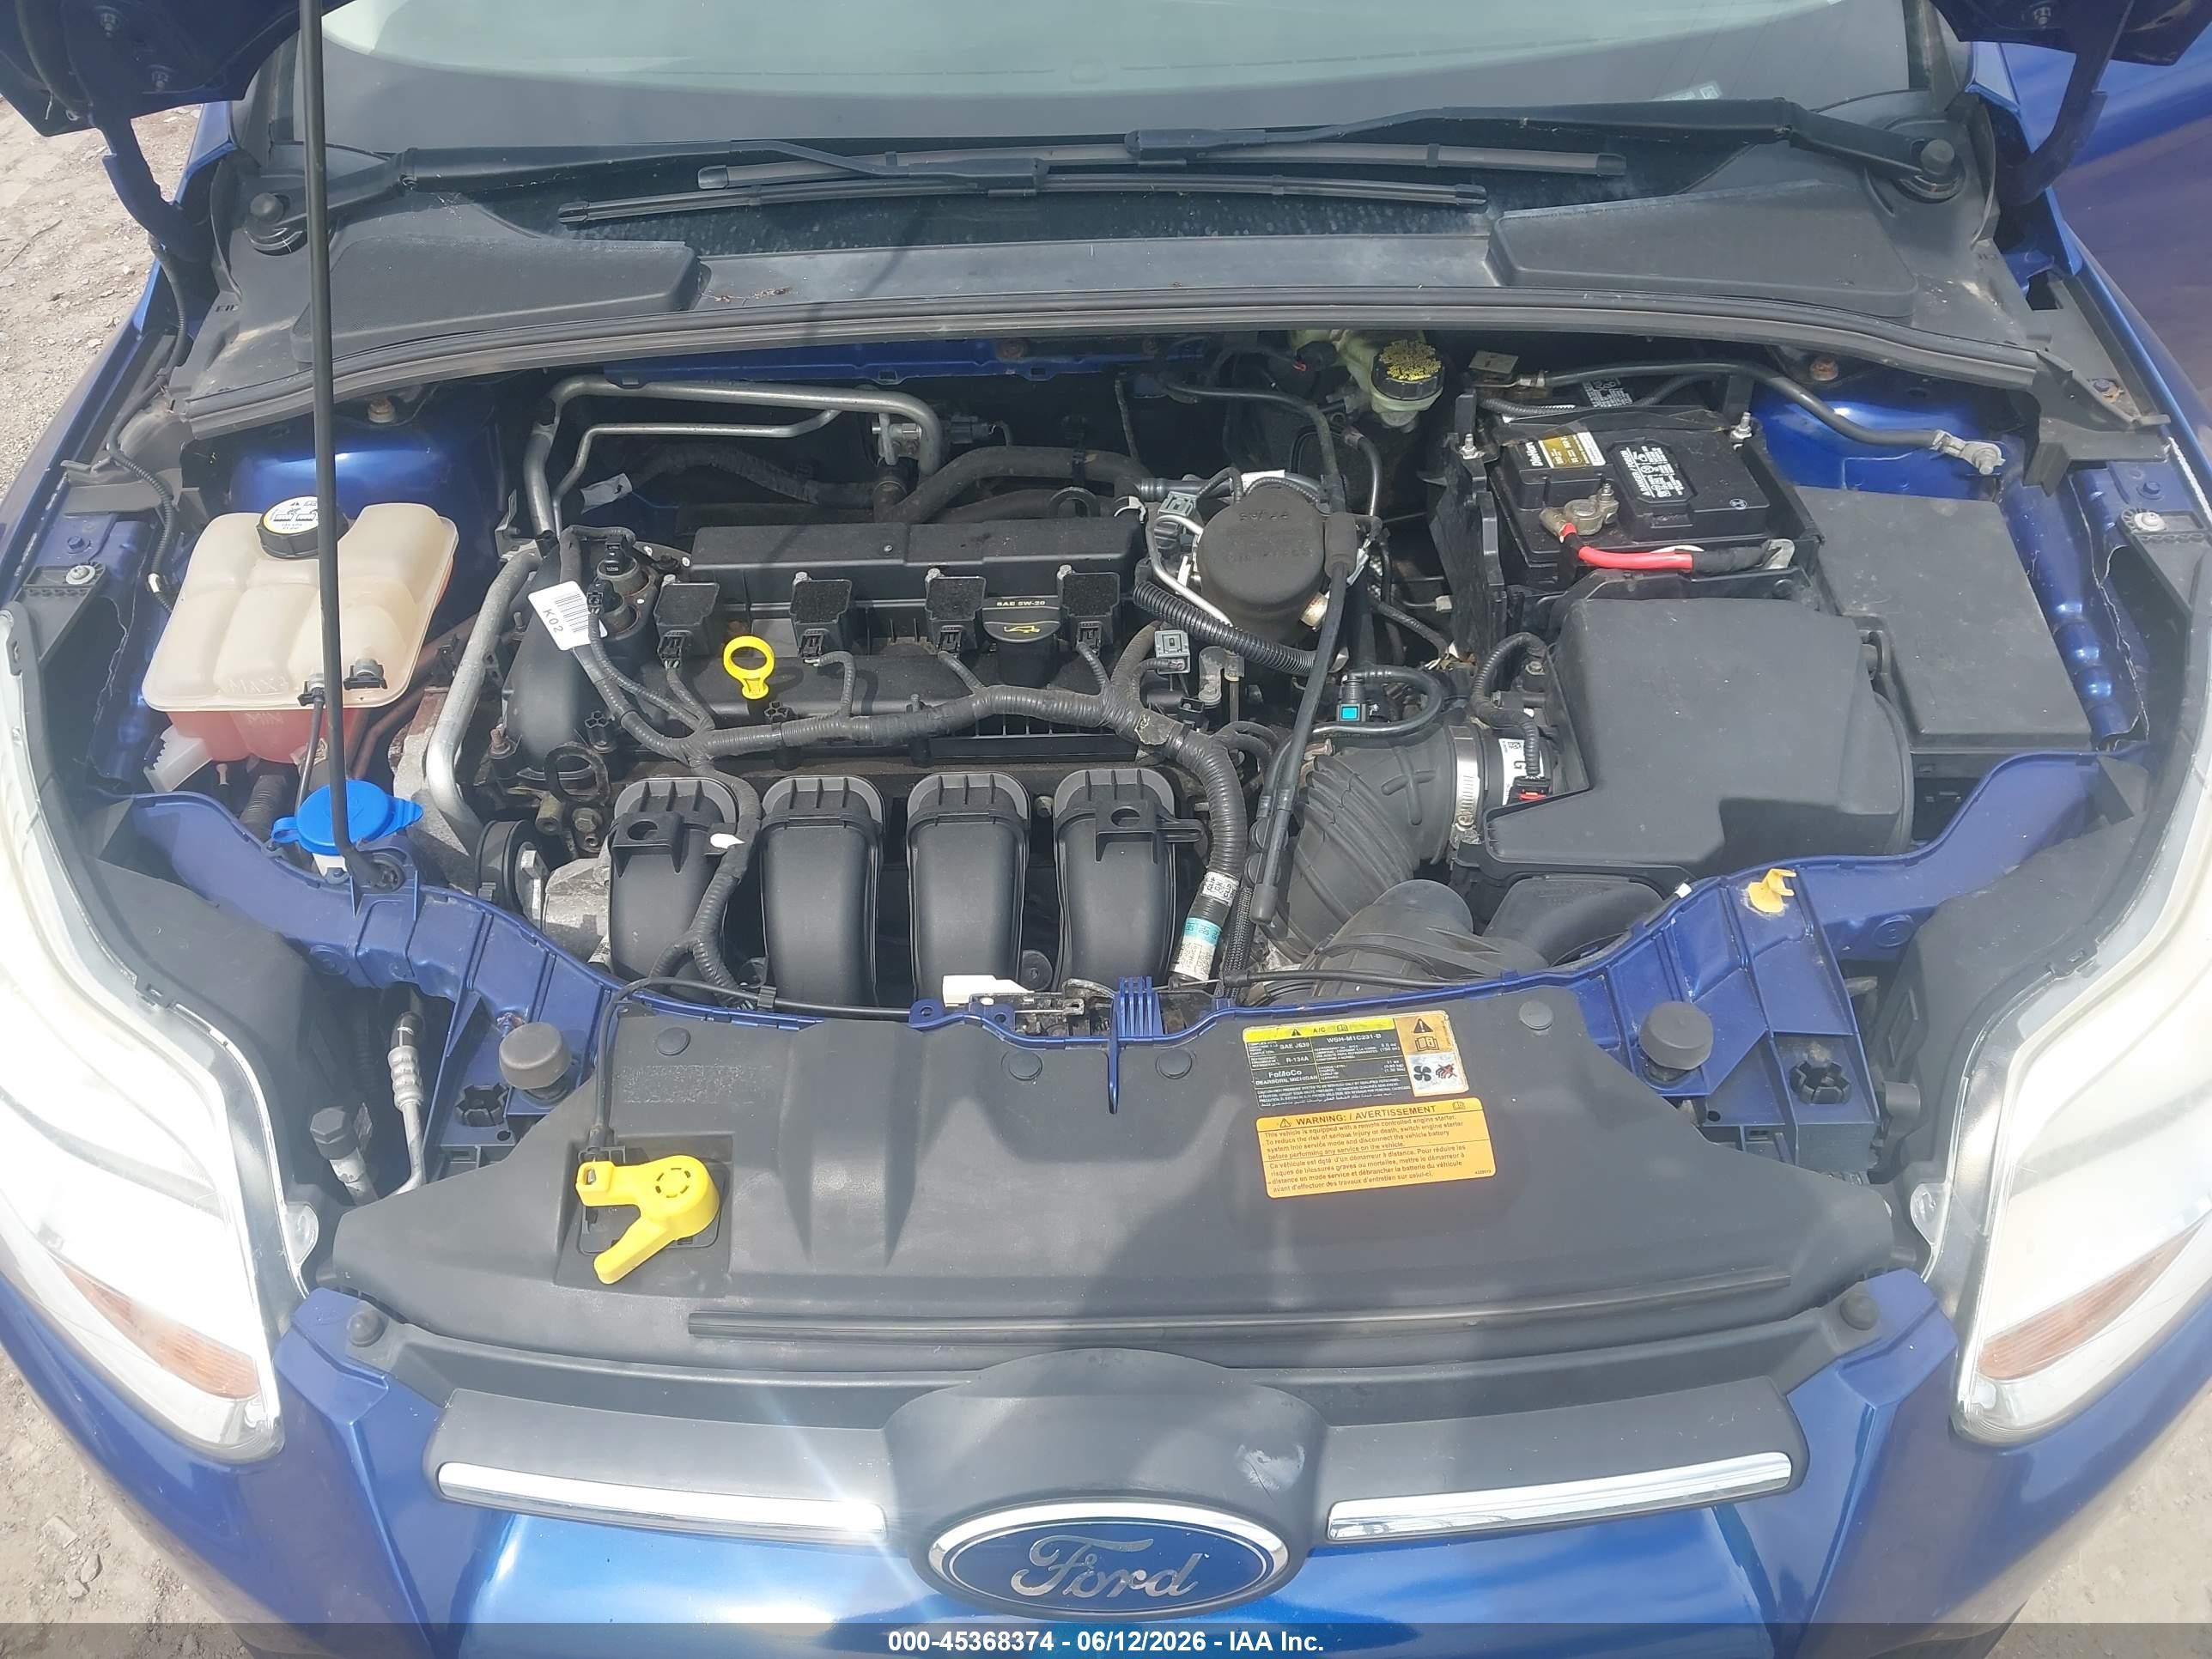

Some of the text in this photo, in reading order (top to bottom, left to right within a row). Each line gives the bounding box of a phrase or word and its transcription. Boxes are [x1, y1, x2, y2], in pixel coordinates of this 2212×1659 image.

[543, 608, 564, 633] K02
[1296, 1114, 1346, 1125] WARNING:
[1354, 1105, 1437, 1119] AVERTISSEMENT
[1309, 1126, 1337, 1134] equipped
[1289, 1149, 1323, 1158] performing
[1358, 1167, 1394, 1176] débrancher
[1291, 1182, 1324, 1190] d'effectuer
[1011, 1534, 1203, 1599] Ford
